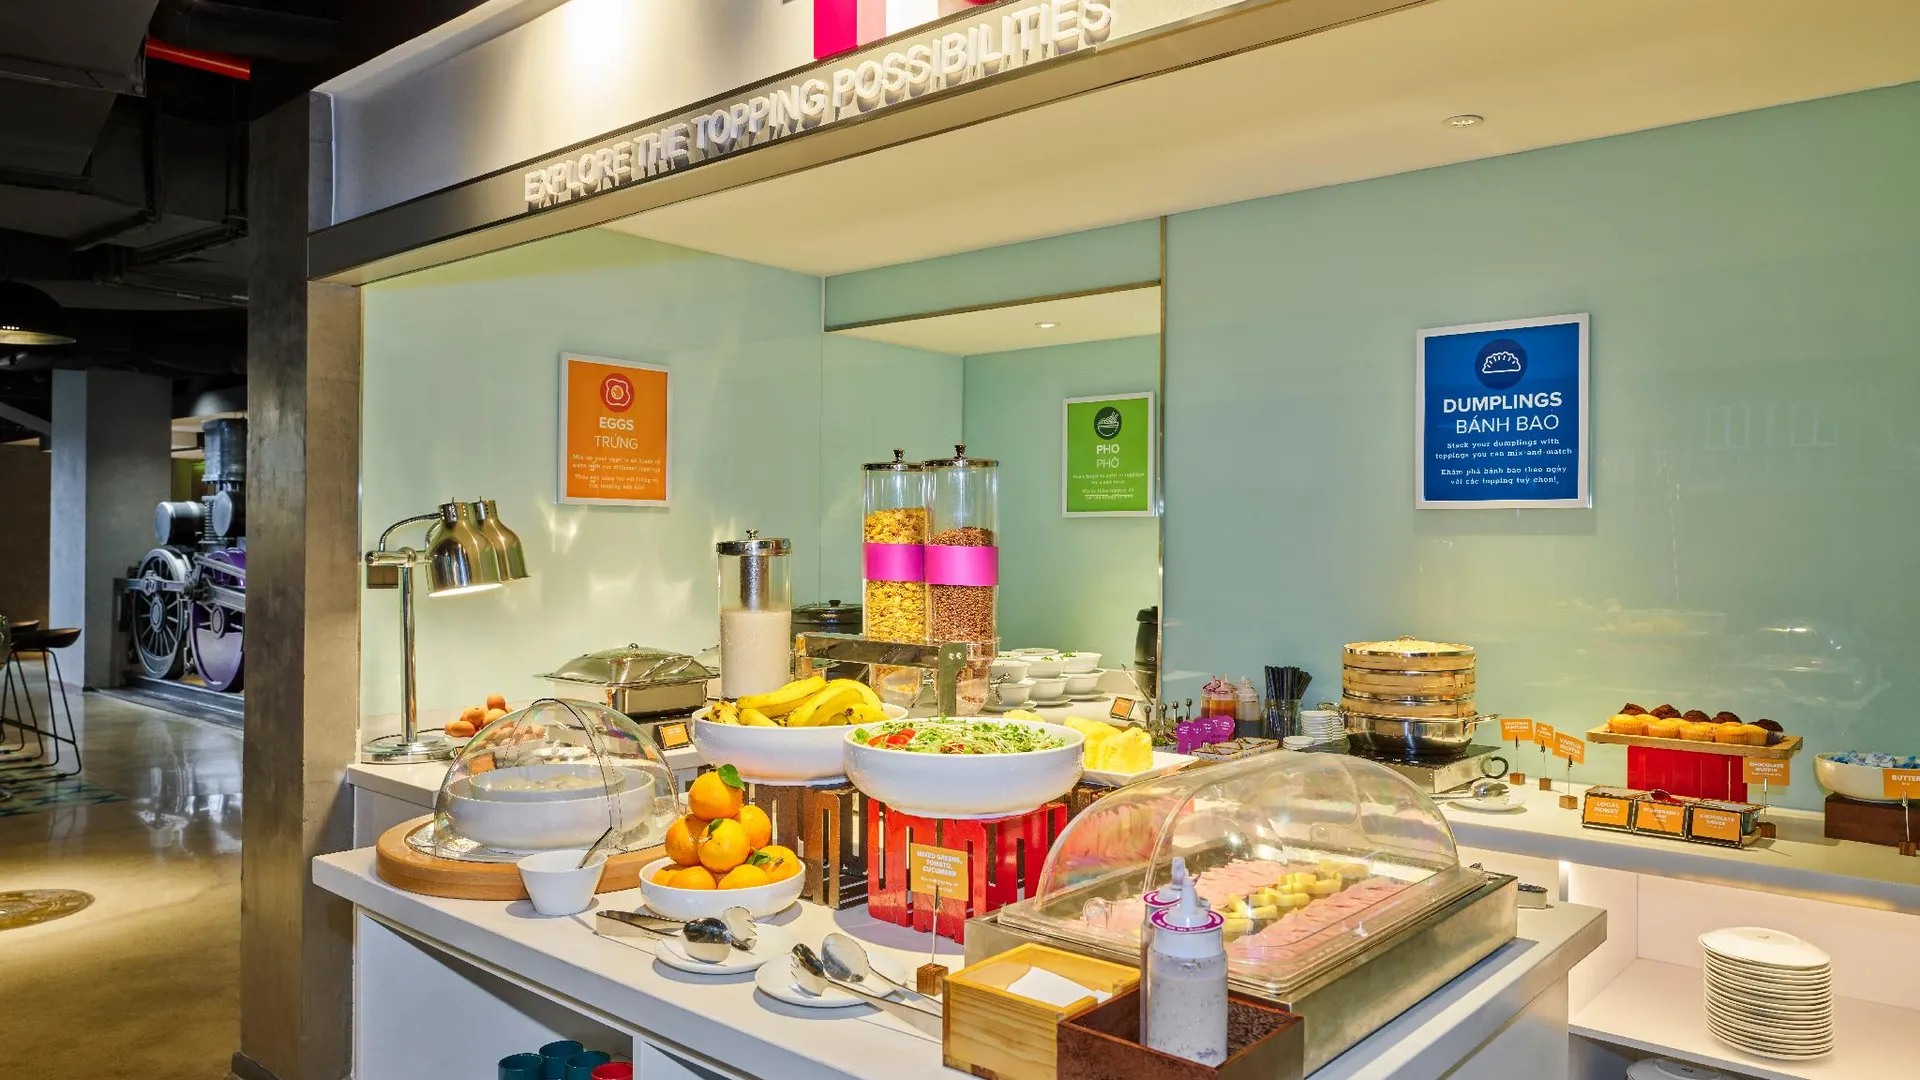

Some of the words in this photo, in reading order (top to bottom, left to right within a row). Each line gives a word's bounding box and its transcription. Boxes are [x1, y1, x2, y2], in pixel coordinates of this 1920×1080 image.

[525, 141, 631, 203] EXPLORE
[633, 122, 691, 168] THE
[692, 78, 826, 150] TOPPING
[833, 0, 1114, 108] POSSIBILITIES
[1443, 392, 1562, 414] DUMPLINGS
[600, 417, 634, 430] EGGS
[1456, 415, 1510, 434] BÁNH
[1516, 414, 1559, 431] BAO
[1493, 439, 1537, 447] dumplings
[1096, 444, 1120, 454] PHO
[1435, 452, 1469, 460] toppings
[1472, 451, 1487, 459] you
[1507, 448, 1573, 457] mix-and-match
[1482, 477, 1513, 485] topping
[1594, 806, 1619, 814] HONEY
[1596, 801, 1620, 809] LOCAL
